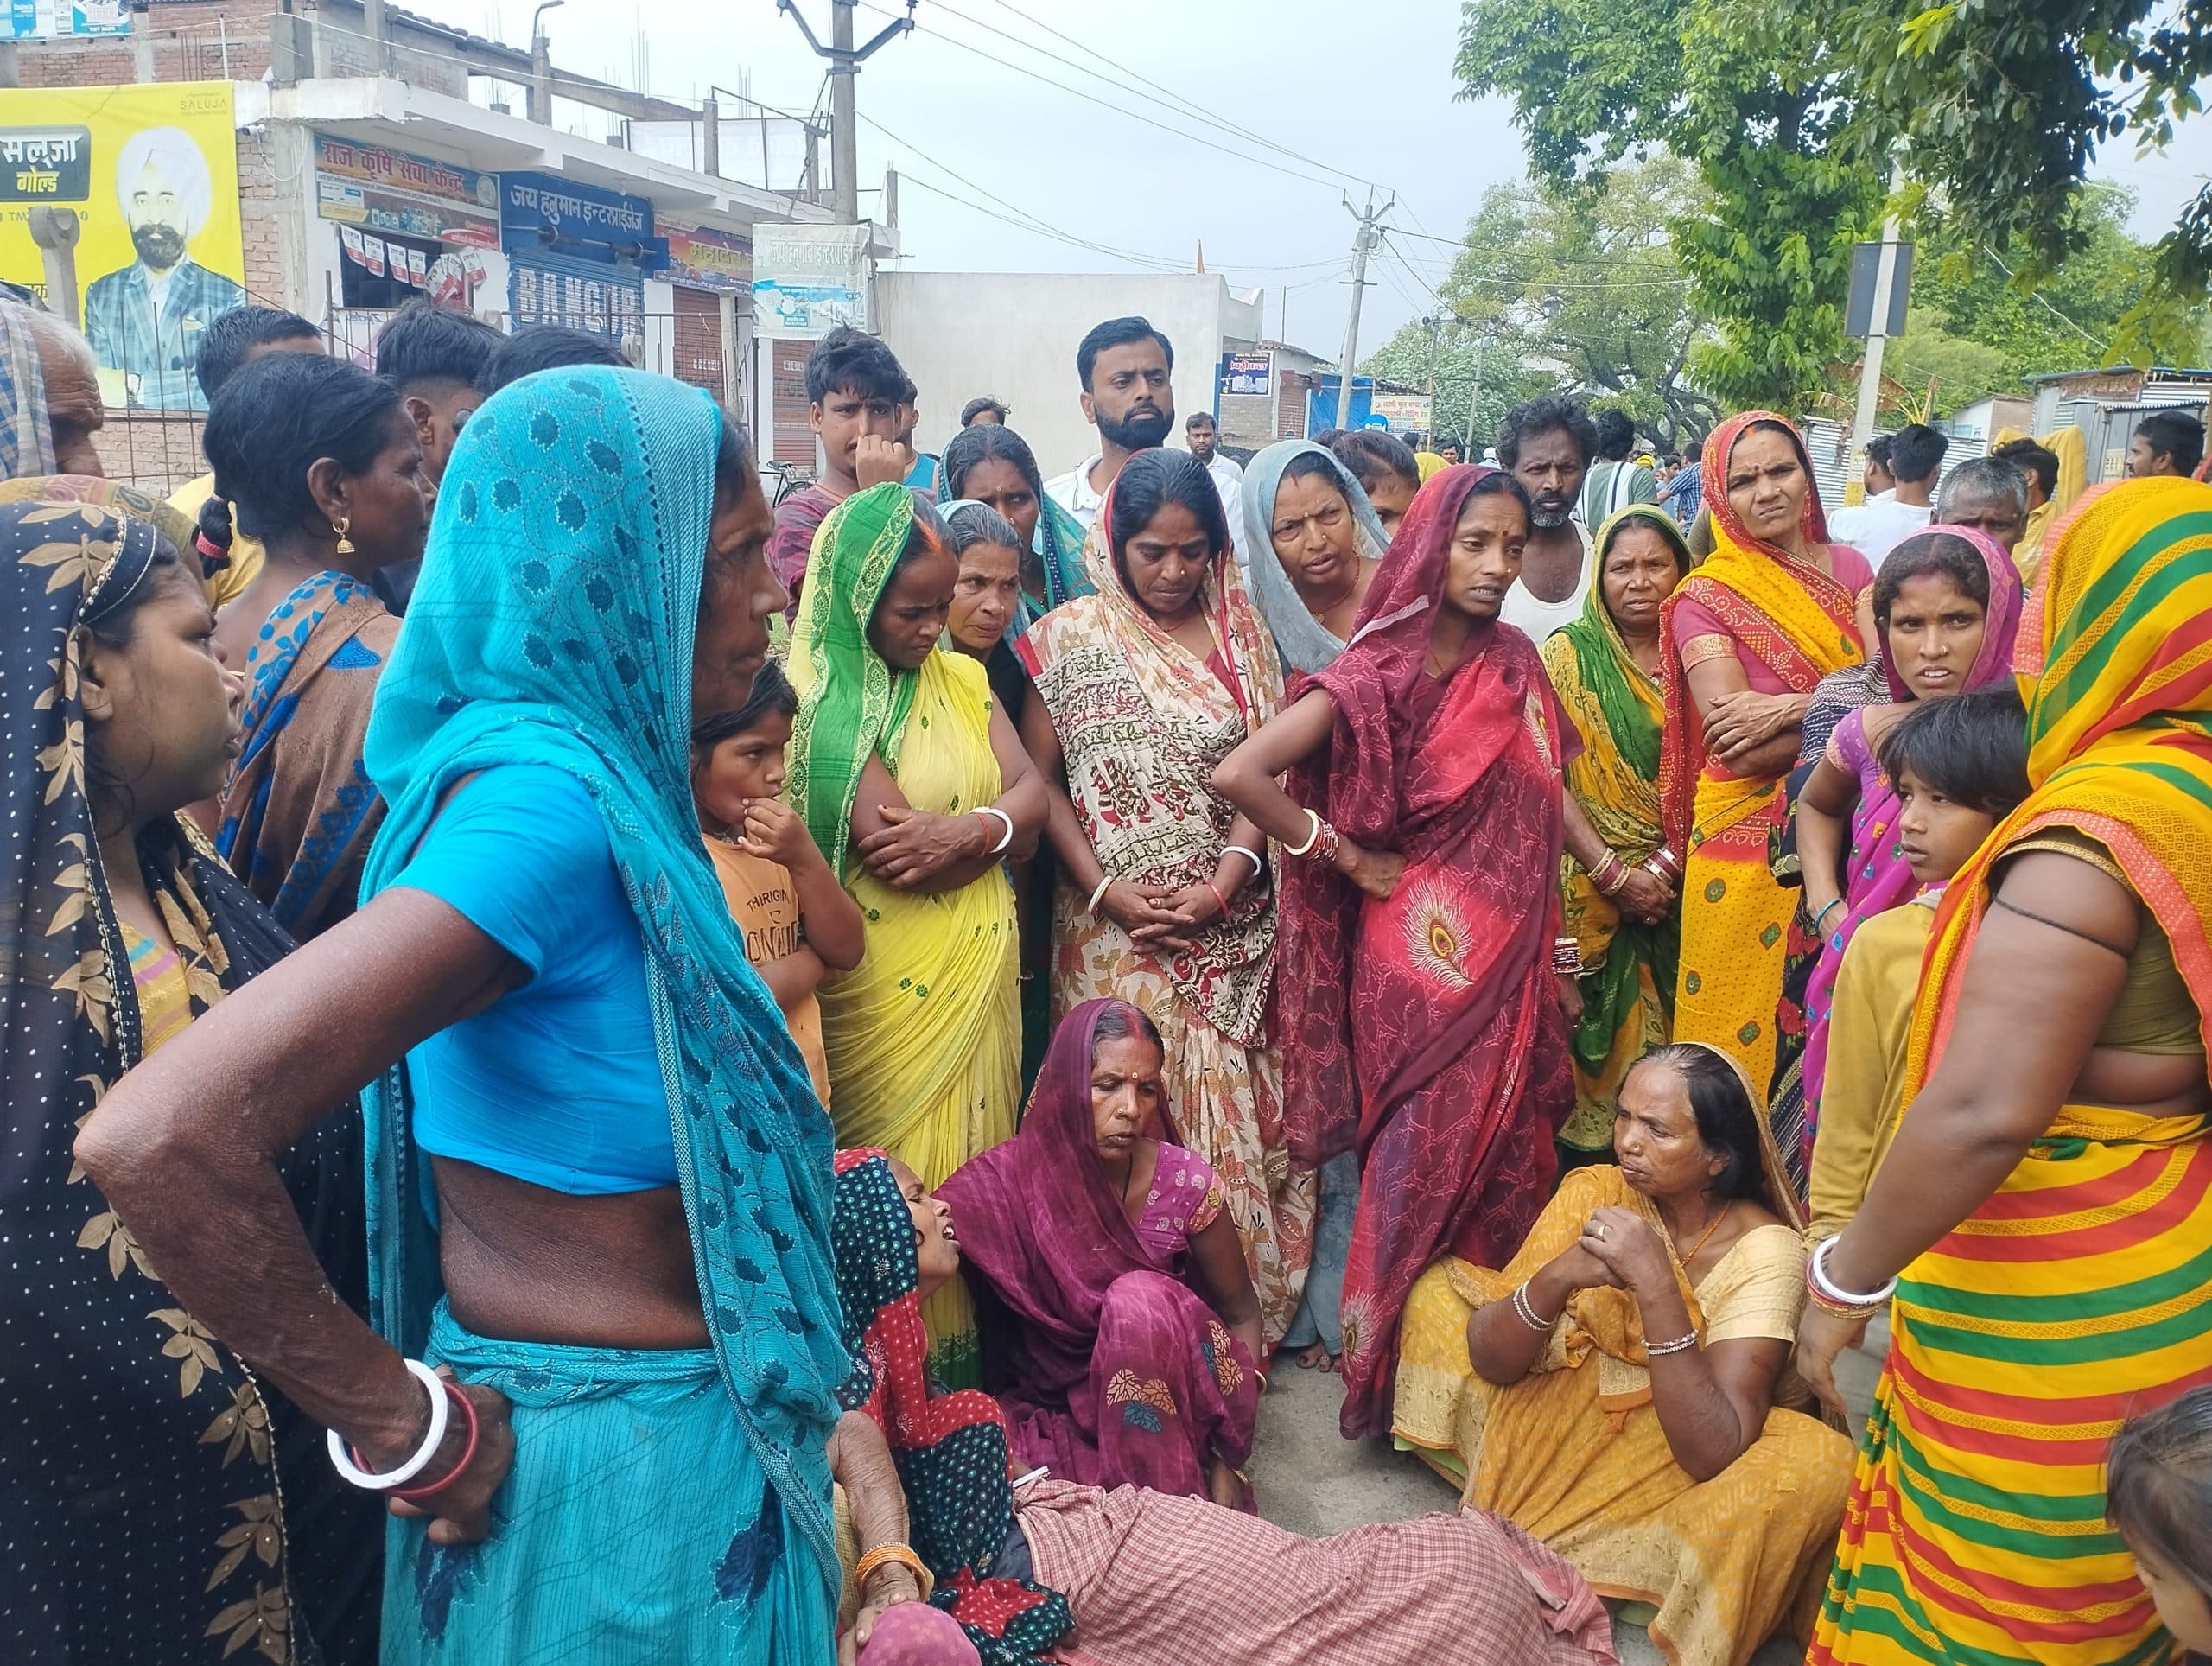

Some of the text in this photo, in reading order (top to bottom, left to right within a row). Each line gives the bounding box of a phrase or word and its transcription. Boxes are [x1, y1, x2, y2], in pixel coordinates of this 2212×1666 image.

[180, 98, 228, 111] SALUJA
[0, 134, 83, 169] सलूजा
[321, 140, 354, 169] राज
[359, 145, 394, 181] कृषि
[398, 153, 429, 185] सेवा
[432, 162, 465, 194] केन्द्र
[16, 165, 60, 193] गोल्ड
[8, 211, 29, 222] TM
[510, 184, 539, 209] जय
[540, 191, 582, 226] हनुमान
[518, 268, 638, 335] BANGUR
